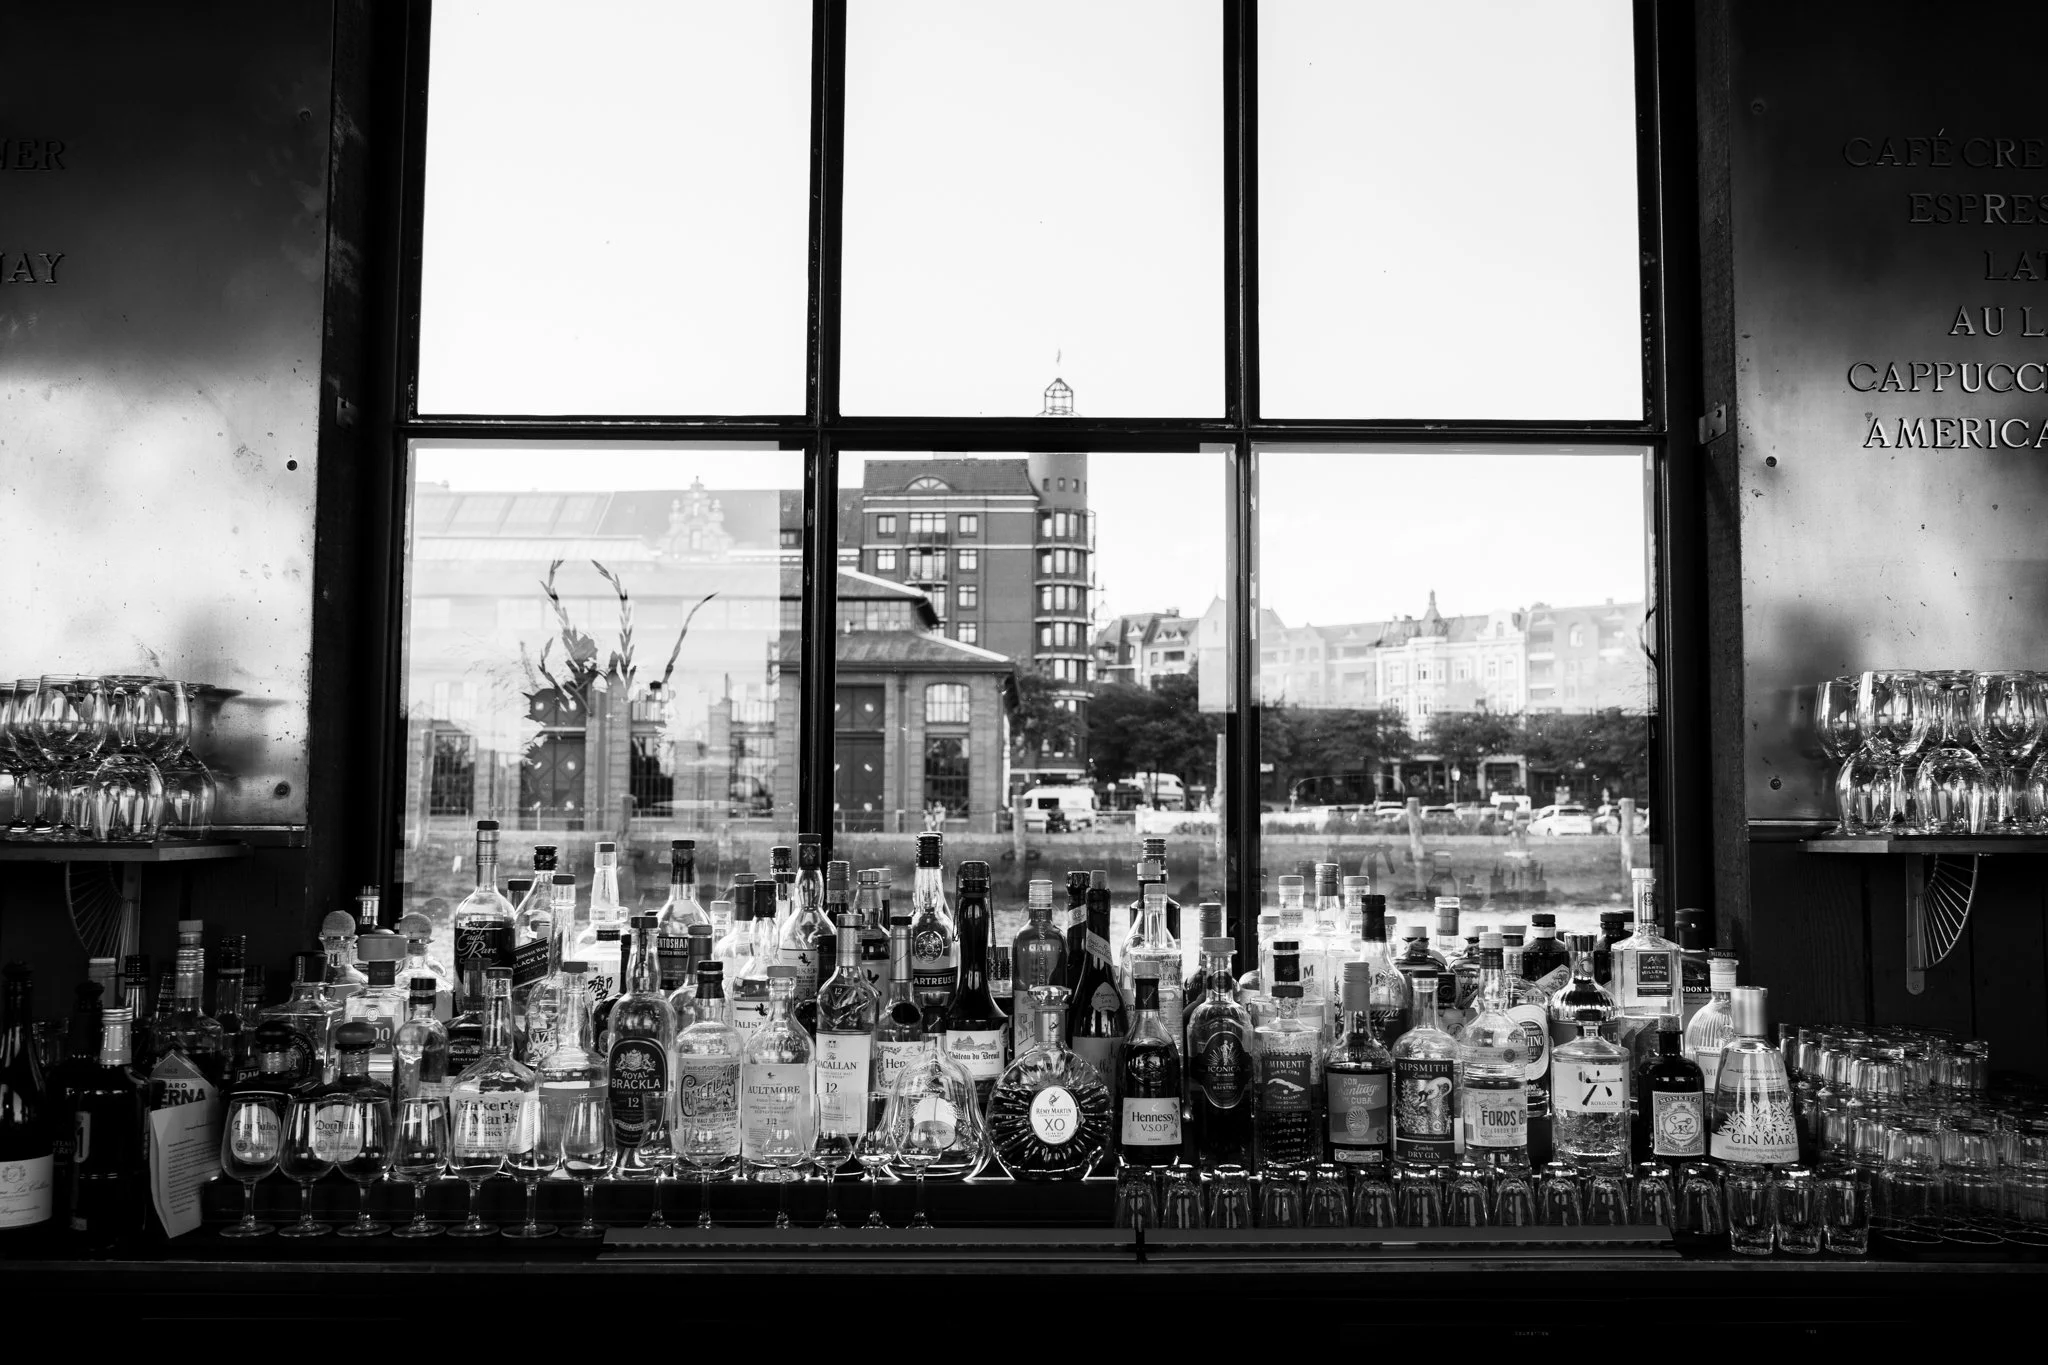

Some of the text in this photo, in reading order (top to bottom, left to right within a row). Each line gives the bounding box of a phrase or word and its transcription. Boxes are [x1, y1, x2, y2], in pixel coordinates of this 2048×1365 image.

[1843, 128, 1953, 168] CAFÉ
[0, 252, 65, 284] AY
[1949, 304, 2048, 337] AU L
[1847, 362, 2048, 394] CAPPUCC
[1399, 1062, 1449, 1073] SIPSMITH
[621, 1070, 649, 1080] ROYAL
[610, 1078, 661, 1090] BRACKLA
[747, 1085, 801, 1095] AULTMORE
[825, 1082, 838, 1094] 12
[627, 1097, 640, 1108] 12
[1131, 1111, 1174, 1125] Hennessy
[1481, 1110, 1517, 1127] FORDS
[1044, 1118, 1065, 1132] XO
[1376, 1127, 1385, 1142] 8
[1731, 1133, 1796, 1146] GIN MARE
[1407, 1150, 1441, 1159] DRY GIN
